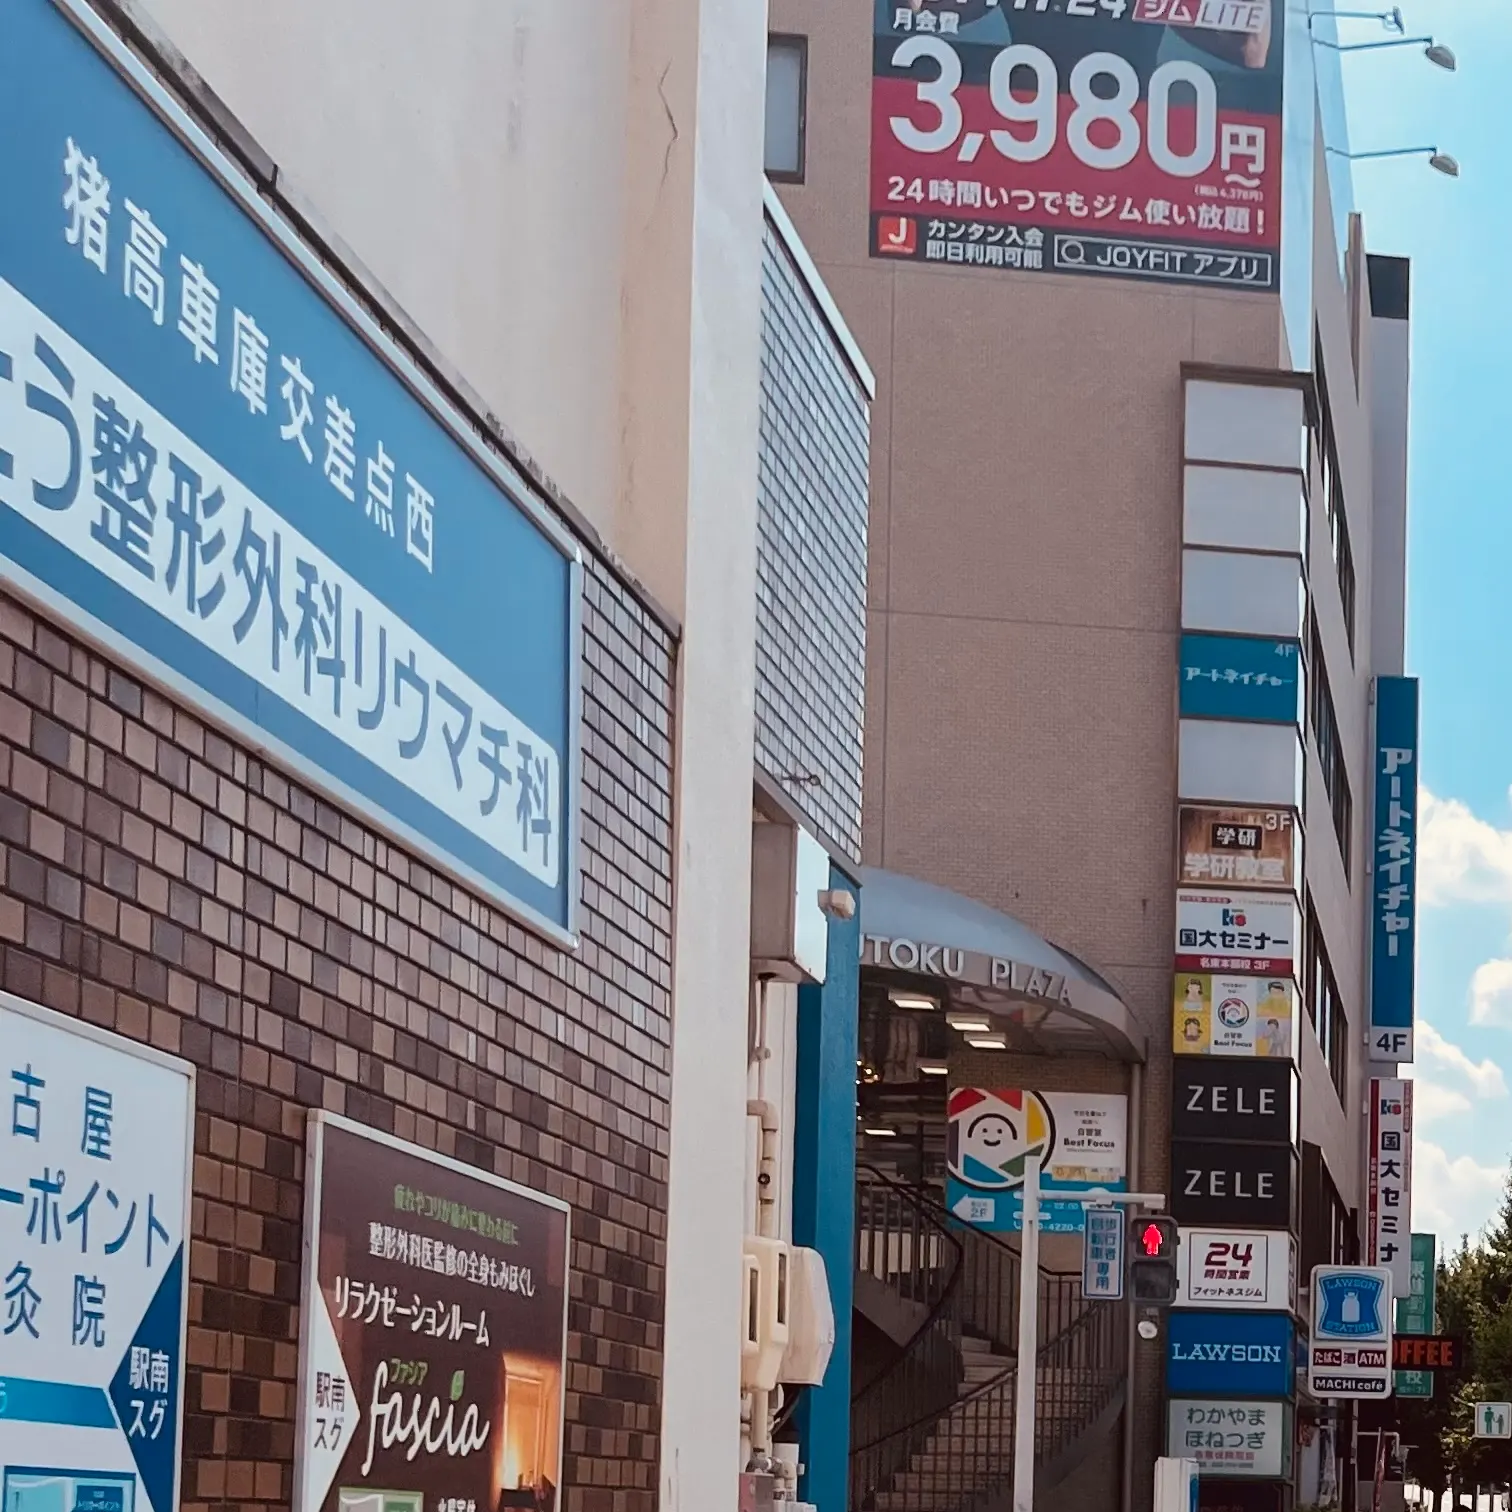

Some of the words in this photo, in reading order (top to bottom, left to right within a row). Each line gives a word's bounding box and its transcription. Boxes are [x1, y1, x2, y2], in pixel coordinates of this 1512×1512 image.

[893, 7, 961, 35] 月会費
[1201, 2, 1265, 29] LITE
[888, 216, 908, 244] J
[927, 219, 1045, 247] カンタン入会
[926, 239, 1043, 270] 即日利用可能
[1096, 247, 1188, 272] JOYFIT
[1193, 252, 1258, 280] アプリ
[62, 136, 436, 576] 猪高車庫交差点西
[1274, 643, 1295, 658] 4F
[1184, 666, 1294, 687] アートネイチャー
[1264, 812, 1292, 832] 3F
[1215, 827, 1257, 847] 学研
[1377, 746, 1413, 958] アートネイチャー
[1184, 852, 1286, 882] 学研教室
[1179, 928, 1290, 950] 国大セミナー
[991, 956, 1074, 1009] PLAZA
[1375, 1033, 1408, 1053] 4F
[12, 1062, 114, 1161] 古屋
[1186, 1085, 1277, 1115] ZELE
[1087, 1138, 1115, 1148] Focus
[1184, 1169, 1275, 1200] ZELE
[367, 1221, 536, 1298] 整形外科医監修の全身もみほぐし
[1204, 1242, 1253, 1267] 24
[1203, 1269, 1251, 1280] 時間営業
[1326, 1278, 1378, 1291] LAWSON
[4, 1260, 107, 1349] 灸院
[1193, 1287, 1263, 1297] フィットネスジム
[335, 1275, 490, 1347] リラクゼーションルーム
[1324, 1320, 1376, 1333] STATION
[1172, 1343, 1282, 1363] LAWSON
[1358, 1353, 1385, 1365] ATM
[130, 1345, 170, 1394] 駅南
[315, 1371, 346, 1413] 駅南
[1315, 1379, 1356, 1390] MACHI
[127, 1398, 168, 1441] スグ
[361, 1360, 491, 1477] fascia
[1187, 1407, 1266, 1426] わかやま
[313, 1417, 345, 1451] スグ
[1185, 1430, 1266, 1450] ほねつぎ
